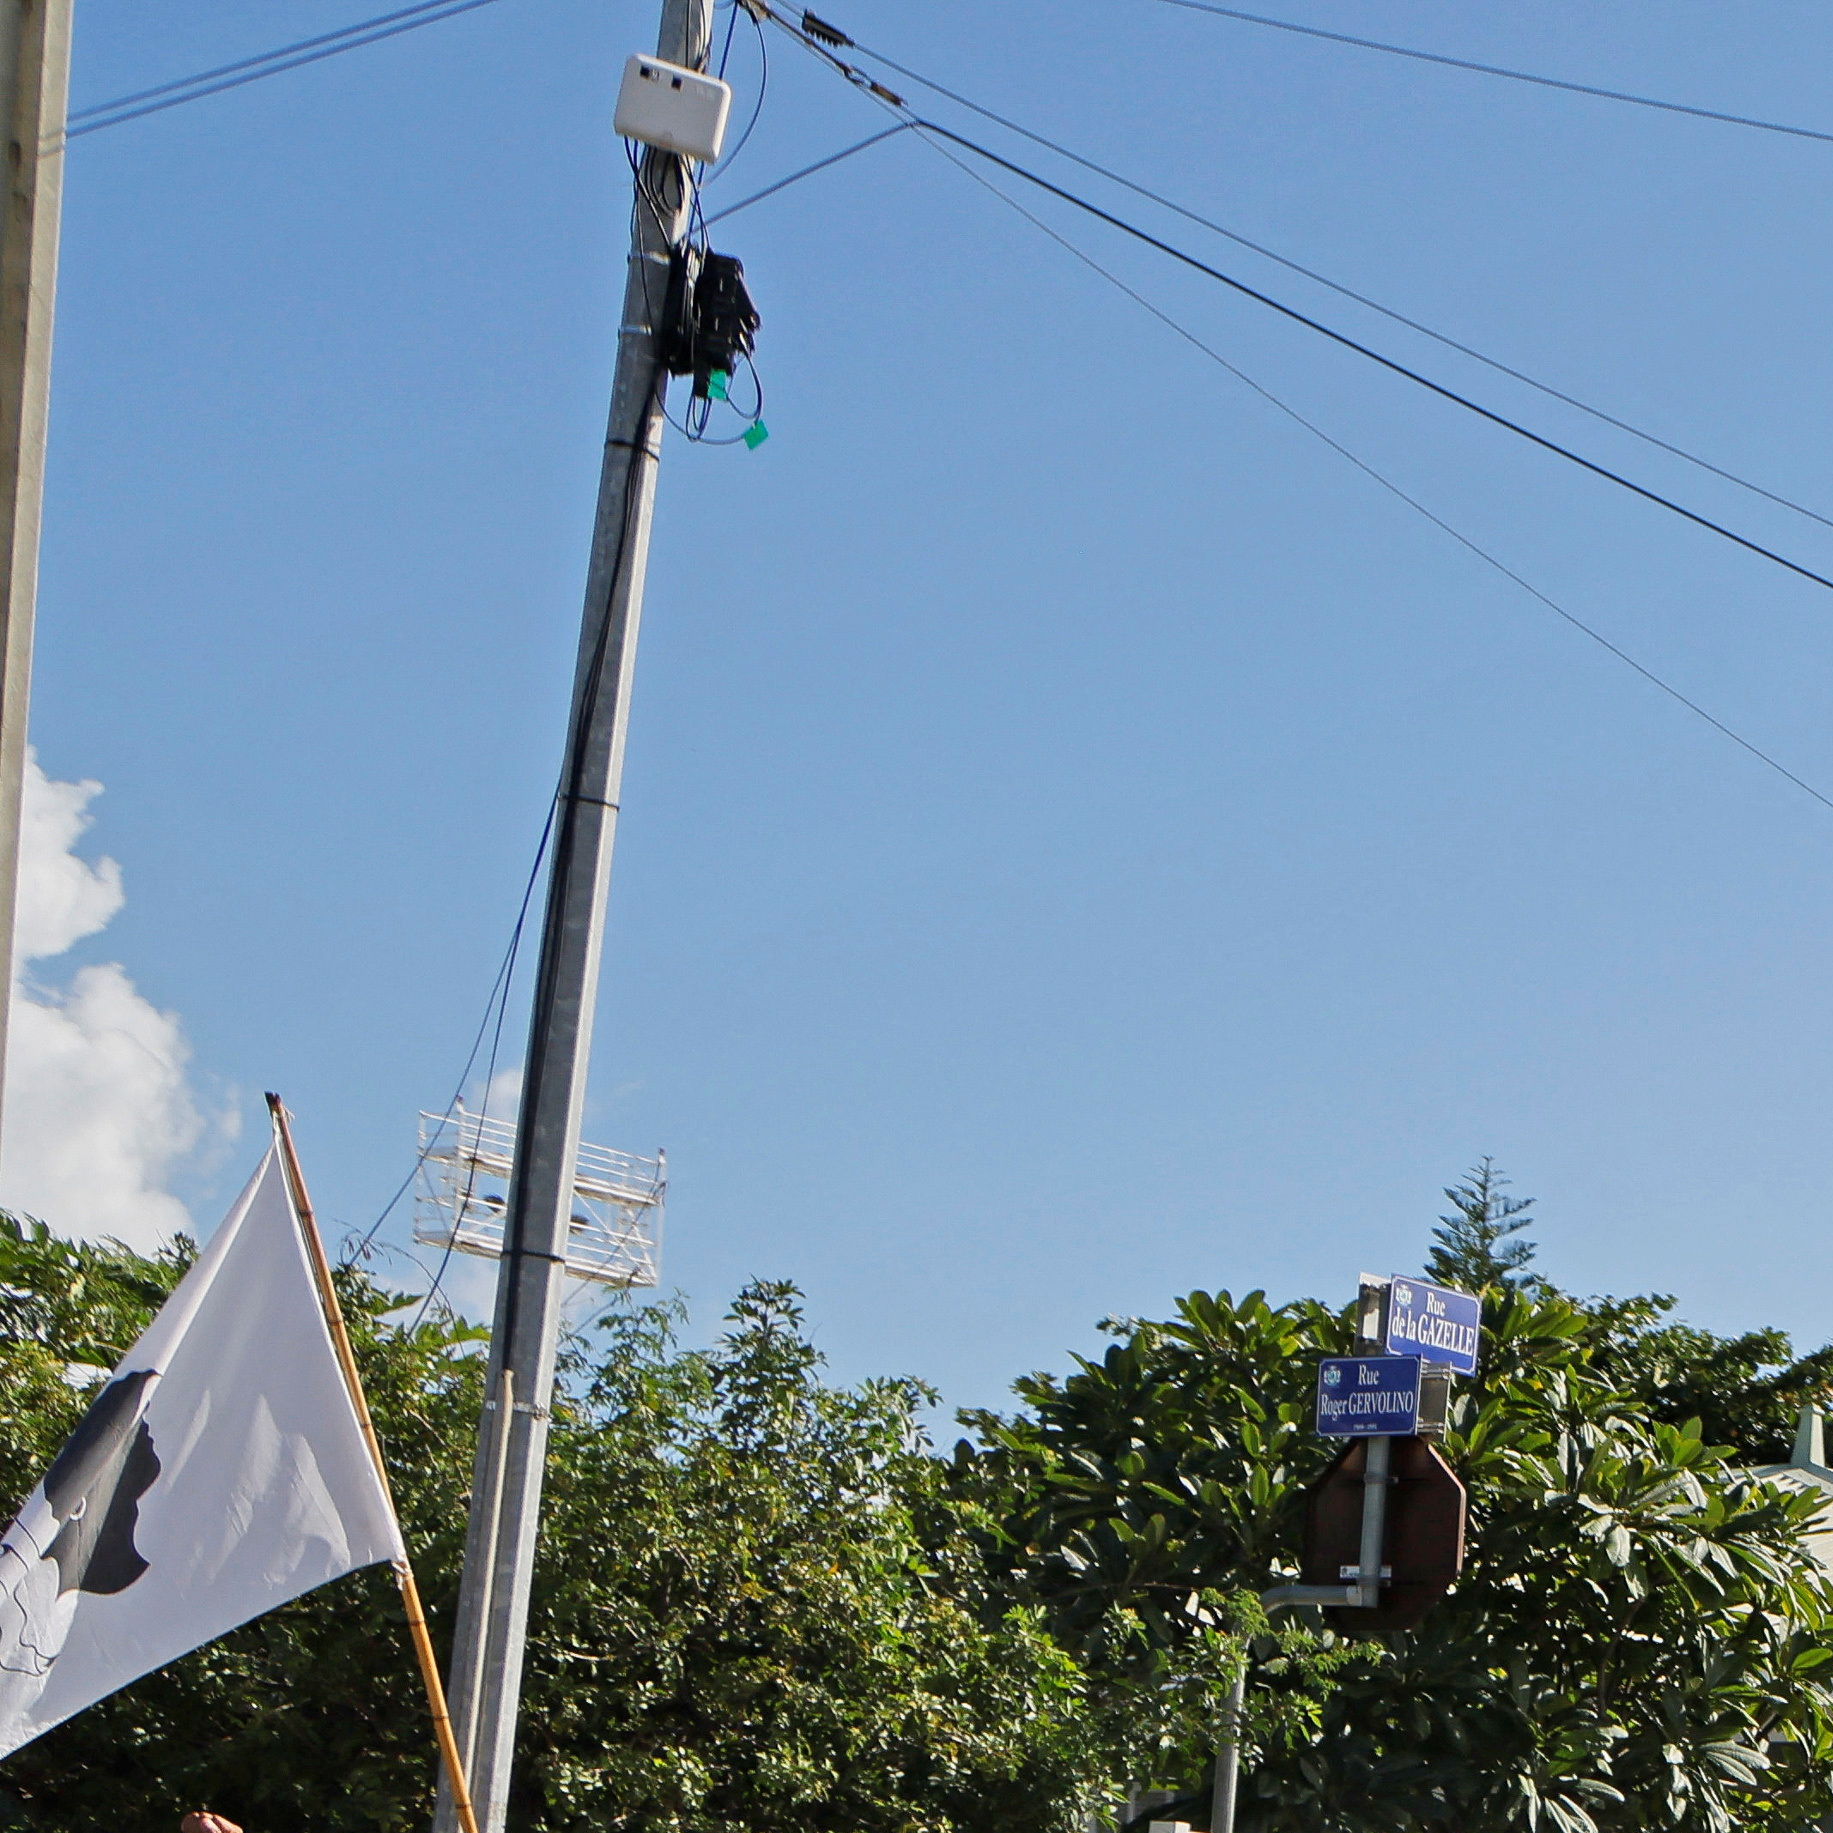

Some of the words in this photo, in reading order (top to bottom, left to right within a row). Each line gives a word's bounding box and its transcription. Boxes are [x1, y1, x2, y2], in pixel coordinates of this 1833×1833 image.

[1426, 1291, 1446, 1317] Rue
[1391, 1306, 1406, 1338] de
[1406, 1309, 1416, 1341] la
[1417, 1313, 1475, 1357] GAZELLE
[1358, 1364, 1380, 1386] Rue
[1320, 1393, 1348, 1421] Roger
[1348, 1390, 1414, 1416] GERVOLINO
